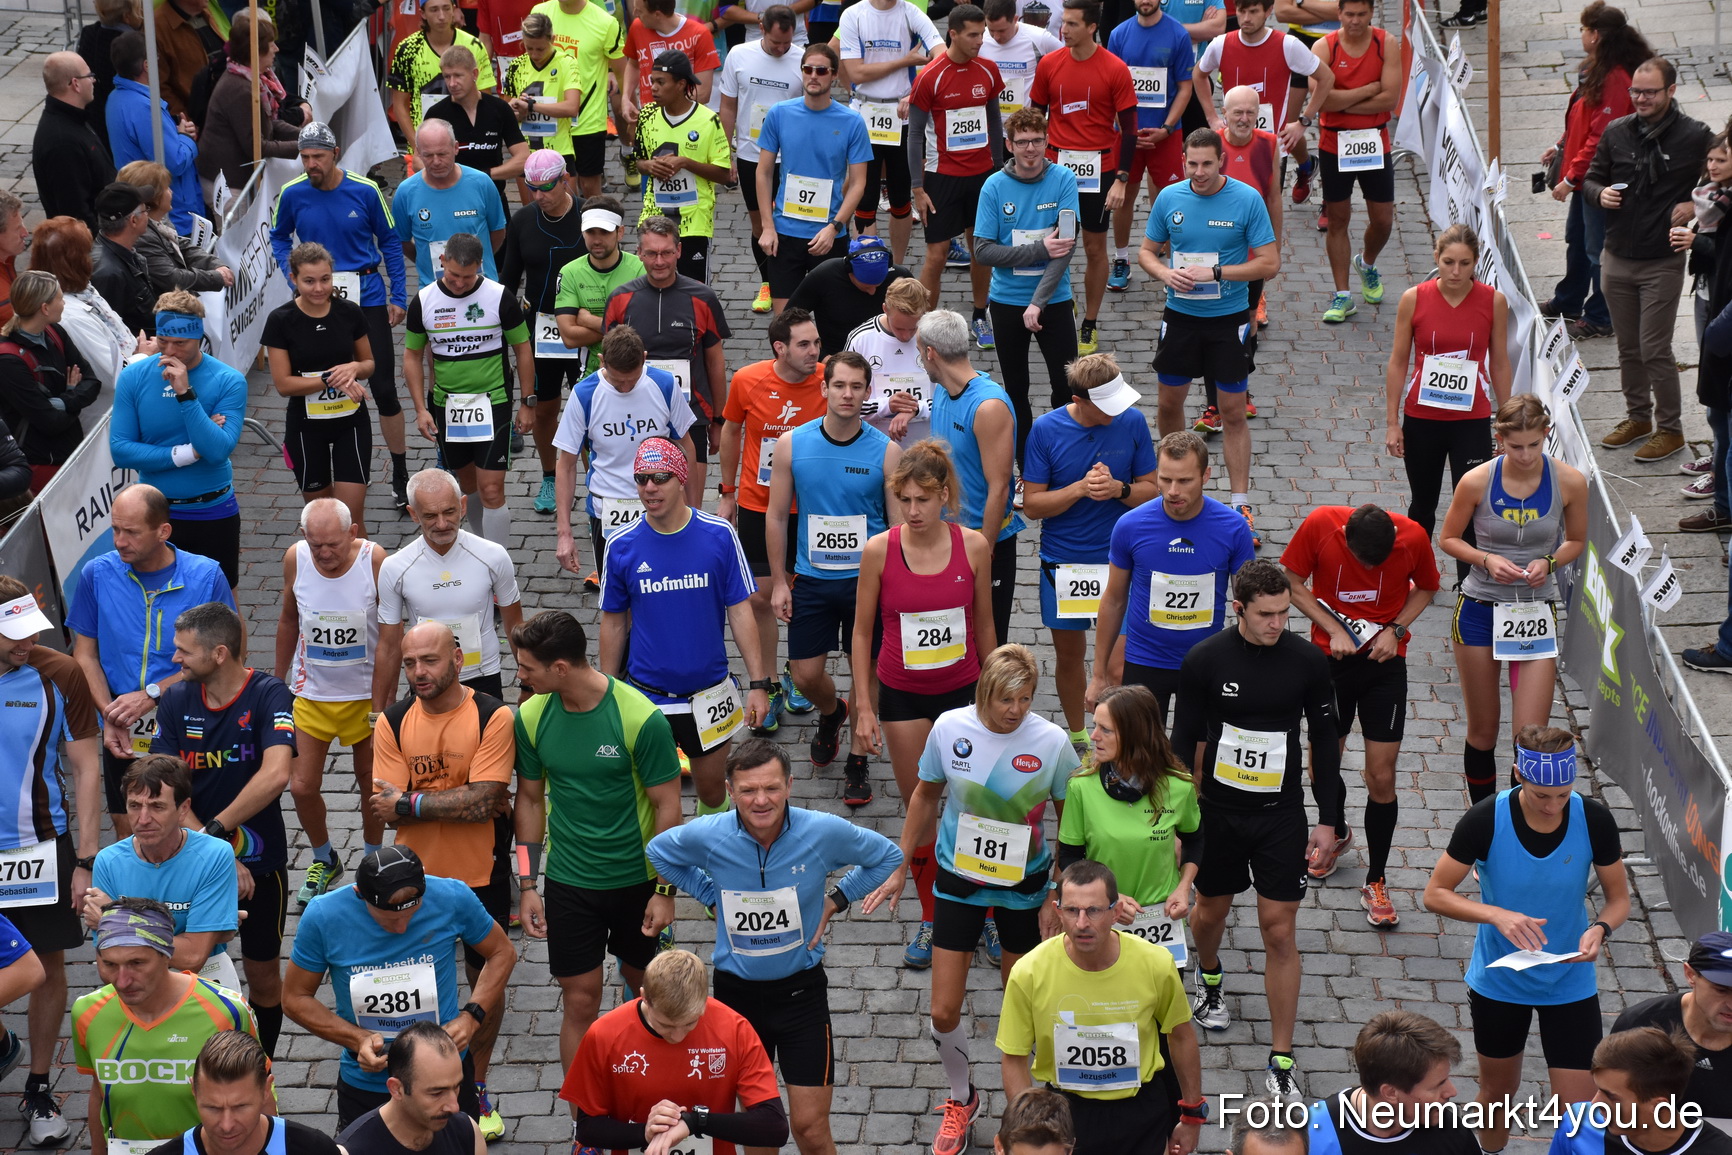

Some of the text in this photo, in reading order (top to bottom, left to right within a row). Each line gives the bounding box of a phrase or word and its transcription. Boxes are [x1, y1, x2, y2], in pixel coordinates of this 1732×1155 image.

[870, 116, 893, 130] 149
[952, 118, 982, 135] 2584
[871, 131, 889, 139] Markus
[959, 136, 977, 144] Thomas
[1344, 141, 1377, 156] 2098
[1349, 157, 1373, 165] Ferdinand
[659, 178, 688, 192] 2681
[798, 189, 816, 204] 97
[453, 209, 478, 217] BOCK
[798, 206, 814, 215] Martin
[1036, 202, 1058, 211] BOCK
[433, 333, 494, 344] Laufteam
[542, 326, 561, 340] 29
[447, 344, 480, 353] Fürth
[1545, 332, 1562, 361] swn
[1428, 371, 1469, 391] 2050
[1562, 367, 1581, 396] swn
[323, 403, 344, 412] Larissa
[450, 407, 485, 424] 2776
[844, 465, 870, 476] THULE
[609, 509, 647, 527] 244
[828, 520, 850, 528] BOCK
[816, 531, 859, 549] 2655
[1168, 546, 1195, 554] skinfit
[1620, 541, 1639, 566] sw
[824, 553, 851, 562] Matthias
[639, 573, 709, 594] Hofmühl
[1068, 579, 1101, 598] 299
[1175, 579, 1198, 587] BOCK
[1653, 572, 1677, 603] swn
[1165, 591, 1200, 610] 227
[926, 614, 949, 623] BOCK
[1165, 613, 1198, 622] Christoph
[1502, 618, 1548, 638] 2428
[311, 627, 358, 645] 2182
[917, 626, 952, 648] 284
[322, 649, 349, 657] Andreas
[706, 696, 735, 724] 258
[134, 718, 153, 736] 24
[1244, 735, 1269, 744] BOCK
[180, 744, 256, 770] MENSCH
[595, 744, 621, 757] AOK
[951, 759, 972, 769] PARTL
[1015, 757, 1039, 769] Hervis
[1233, 747, 1268, 770] 151
[1237, 771, 1259, 782] Lukas
[984, 823, 1010, 835] BOCK
[1684, 792, 1721, 876] LOUNG
[972, 836, 1009, 862] 181
[978, 862, 998, 874] Heidi
[0, 885, 38, 896] Sebastian
[750, 896, 776, 905] BOCK
[734, 909, 791, 933] 2024
[750, 935, 782, 946] Michael
[199, 961, 221, 973] OCK
[380, 972, 411, 984] BOCK
[364, 988, 422, 1015] 2381
[377, 1018, 417, 1030] Wolfgang
[1066, 1045, 1127, 1067] 2058
[612, 1062, 635, 1075] Spitz
[1078, 1071, 1118, 1081] Jezussek
